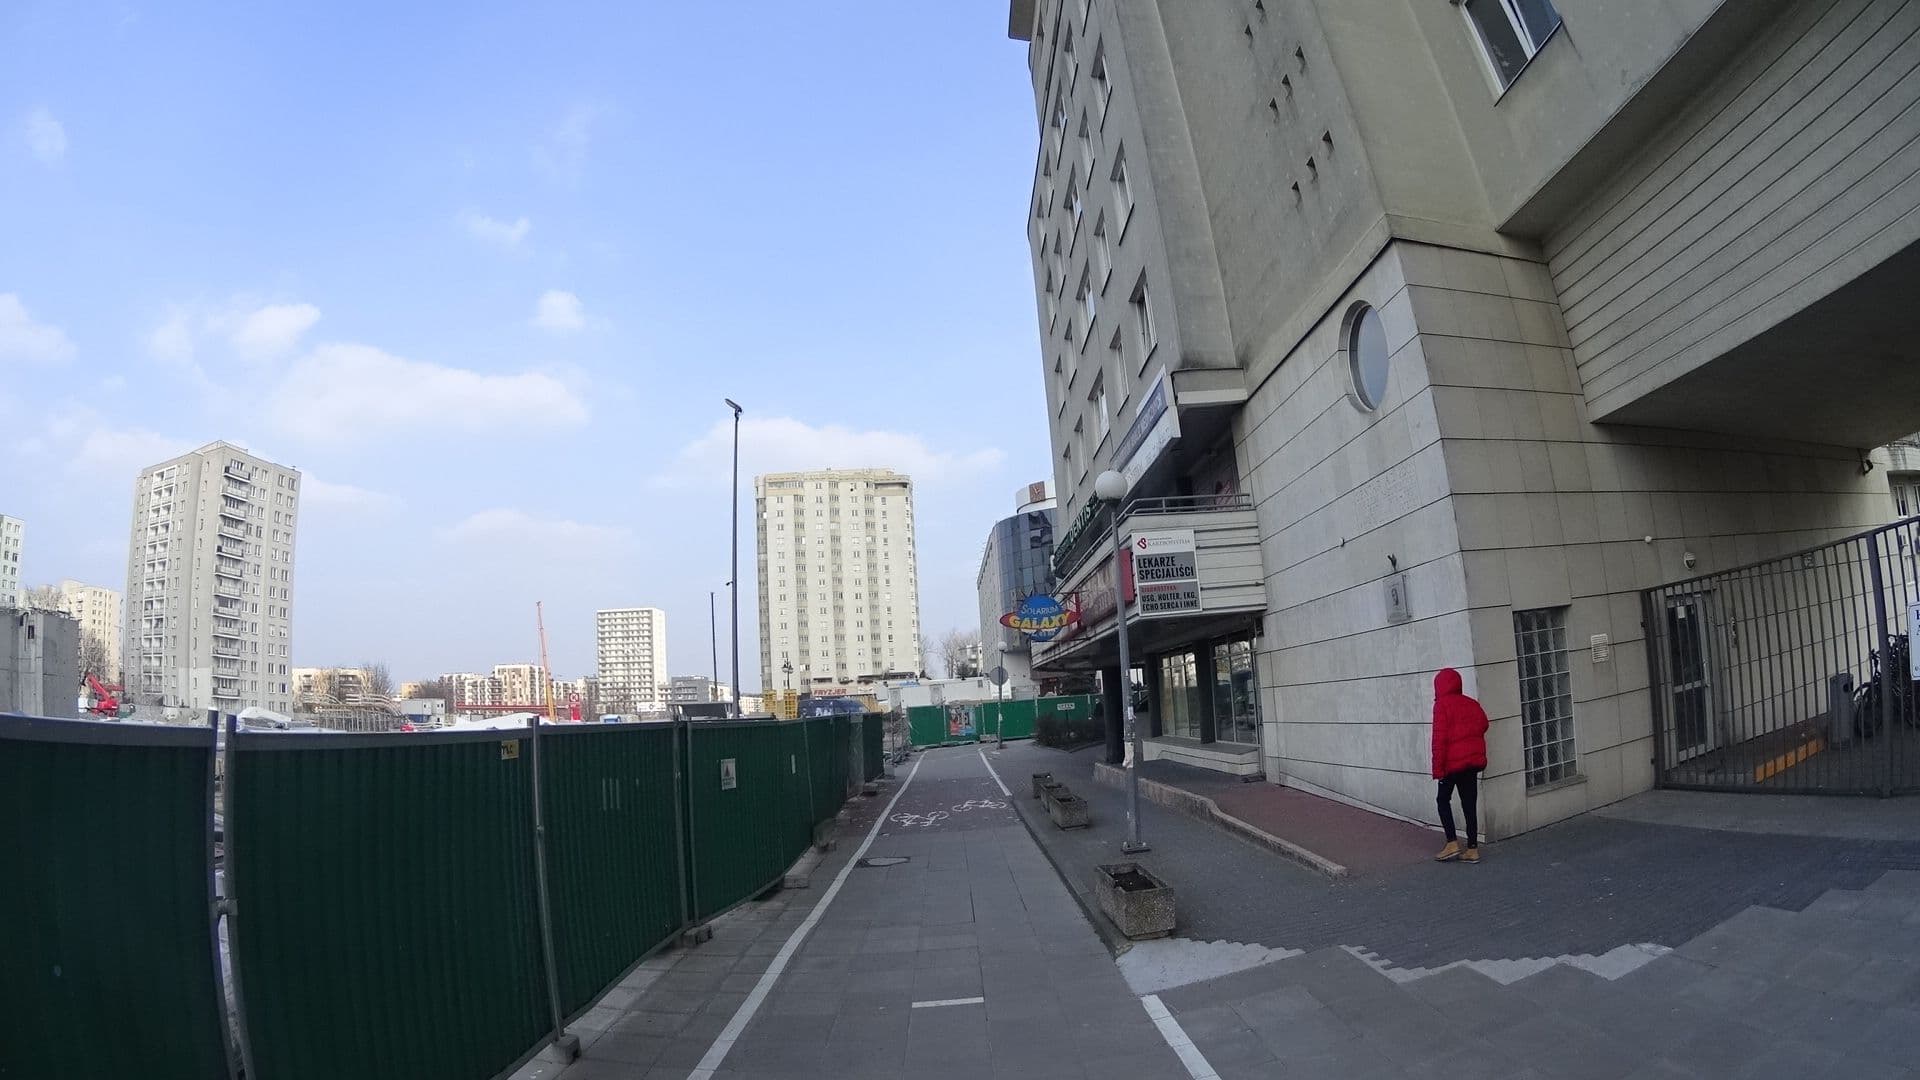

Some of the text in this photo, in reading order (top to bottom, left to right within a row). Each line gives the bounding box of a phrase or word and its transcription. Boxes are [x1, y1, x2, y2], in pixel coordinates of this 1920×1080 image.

[1138, 556, 1176, 569] LEKARZE
[1139, 564, 1194, 580] SPECJALIŚCI
[1021, 604, 1059, 615] SOLARIUM
[1143, 603, 1159, 611] ECHO
[1160, 602, 1179, 610] SERCA
[1009, 612, 1070, 629] GALAXY
[814, 687, 847, 696] FRYZJER
